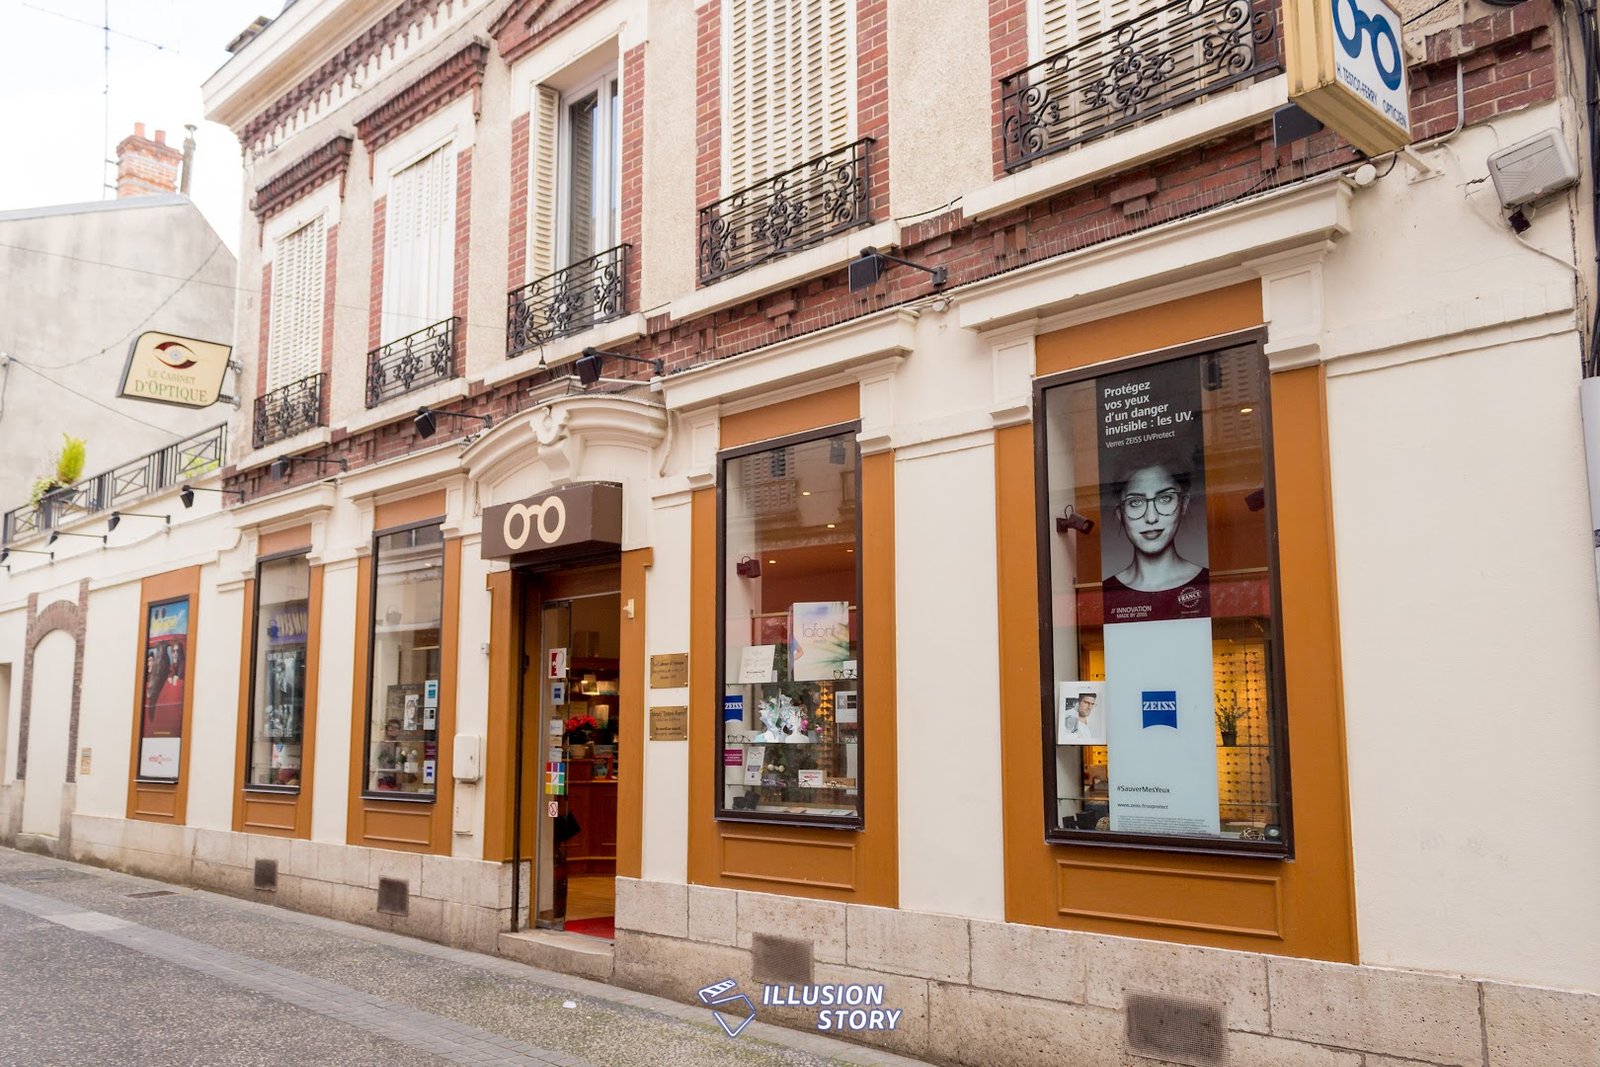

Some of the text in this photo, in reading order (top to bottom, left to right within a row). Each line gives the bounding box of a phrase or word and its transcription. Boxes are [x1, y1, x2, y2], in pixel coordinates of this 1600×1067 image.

[1382, 99, 1408, 129] OPTICIEN
[147, 368, 196, 384] LE CABINET
[135, 379, 208, 403] D'OPTIQUE
[1104, 381, 1151, 398] Protégez
[1104, 394, 1150, 411] vos yeux
[1104, 403, 1169, 423] d'un danger
[1105, 420, 1148, 436] invisible
[1157, 416, 1172, 426] les
[1175, 410, 1194, 423] UV.
[1105, 430, 1176, 449] Verres ZEISS UVProtect
[1116, 605, 1153, 614] INNOVATION
[1142, 700, 1177, 712] ZEISS
[1116, 785, 1171, 794] #SauverMesYeux
